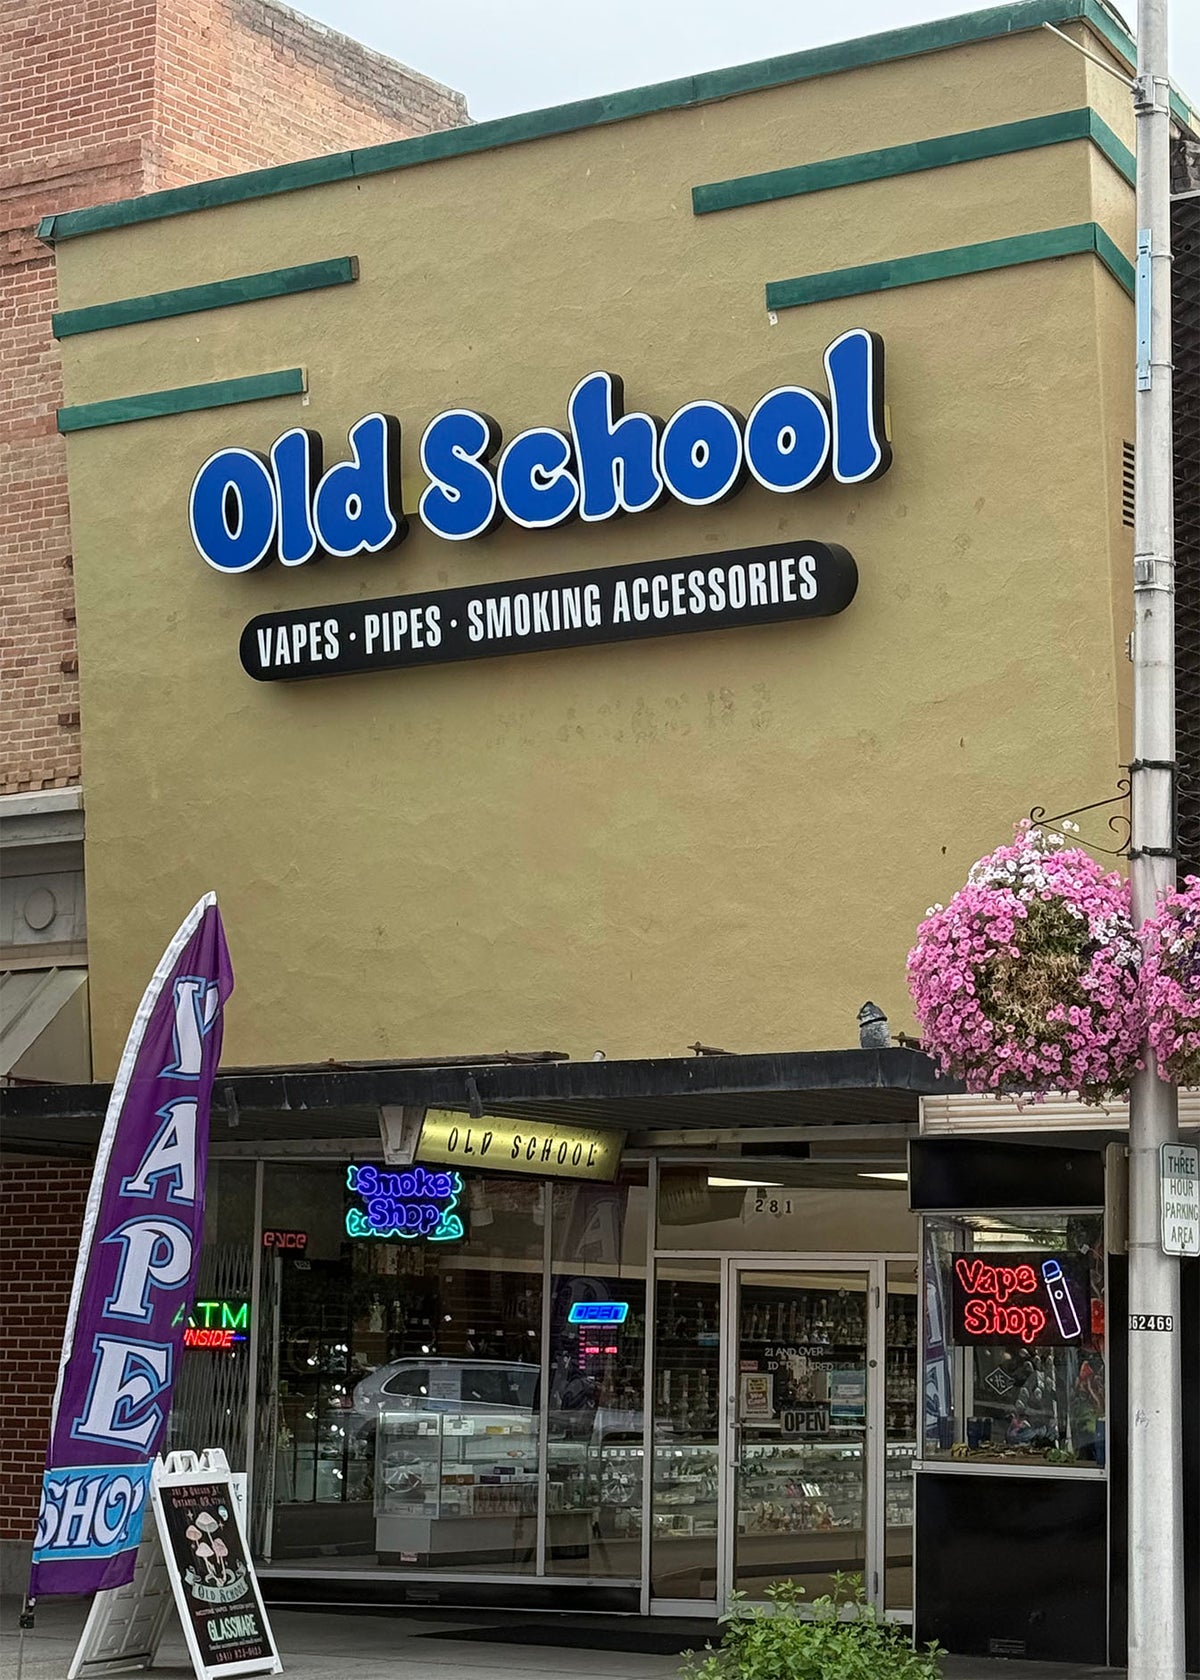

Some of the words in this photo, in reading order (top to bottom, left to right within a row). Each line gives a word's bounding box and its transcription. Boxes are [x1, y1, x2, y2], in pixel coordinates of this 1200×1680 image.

[188, 412, 399, 574] Old
[418, 327, 883, 541] School
[256, 619, 341, 668] VAPES
[364, 606, 443, 655] PIPES
[466, 584, 602, 642] SMOKING
[612, 555, 820, 624] ACCESSORIES
[447, 1127, 493, 1156] OLD
[511, 1135, 597, 1168] SCHOOL
[1168, 1156, 1196, 1175] THREE
[357, 1166, 452, 1197] Smoke
[1170, 1179, 1194, 1197] HOUR
[368, 1198, 440, 1233] Shop
[755, 1199, 793, 1214] 281
[1165, 1203, 1199, 1221] PARKING
[1170, 1226, 1194, 1244] AREA
[955, 1258, 1038, 1303] Vape
[171, 1302, 248, 1329] ATM
[573, 1306, 625, 1320] OPEN
[964, 1299, 1046, 1343] Shop
[183, 1329, 235, 1347] INSIDE
[775, 1347, 797, 1357] AND
[798, 1346, 824, 1356] OVER
[767, 1361, 779, 1370] ID
[784, 1411, 826, 1432] OPEN
[35, 1473, 145, 1551] SHO
[207, 1613, 259, 1642] GLASSWARE
